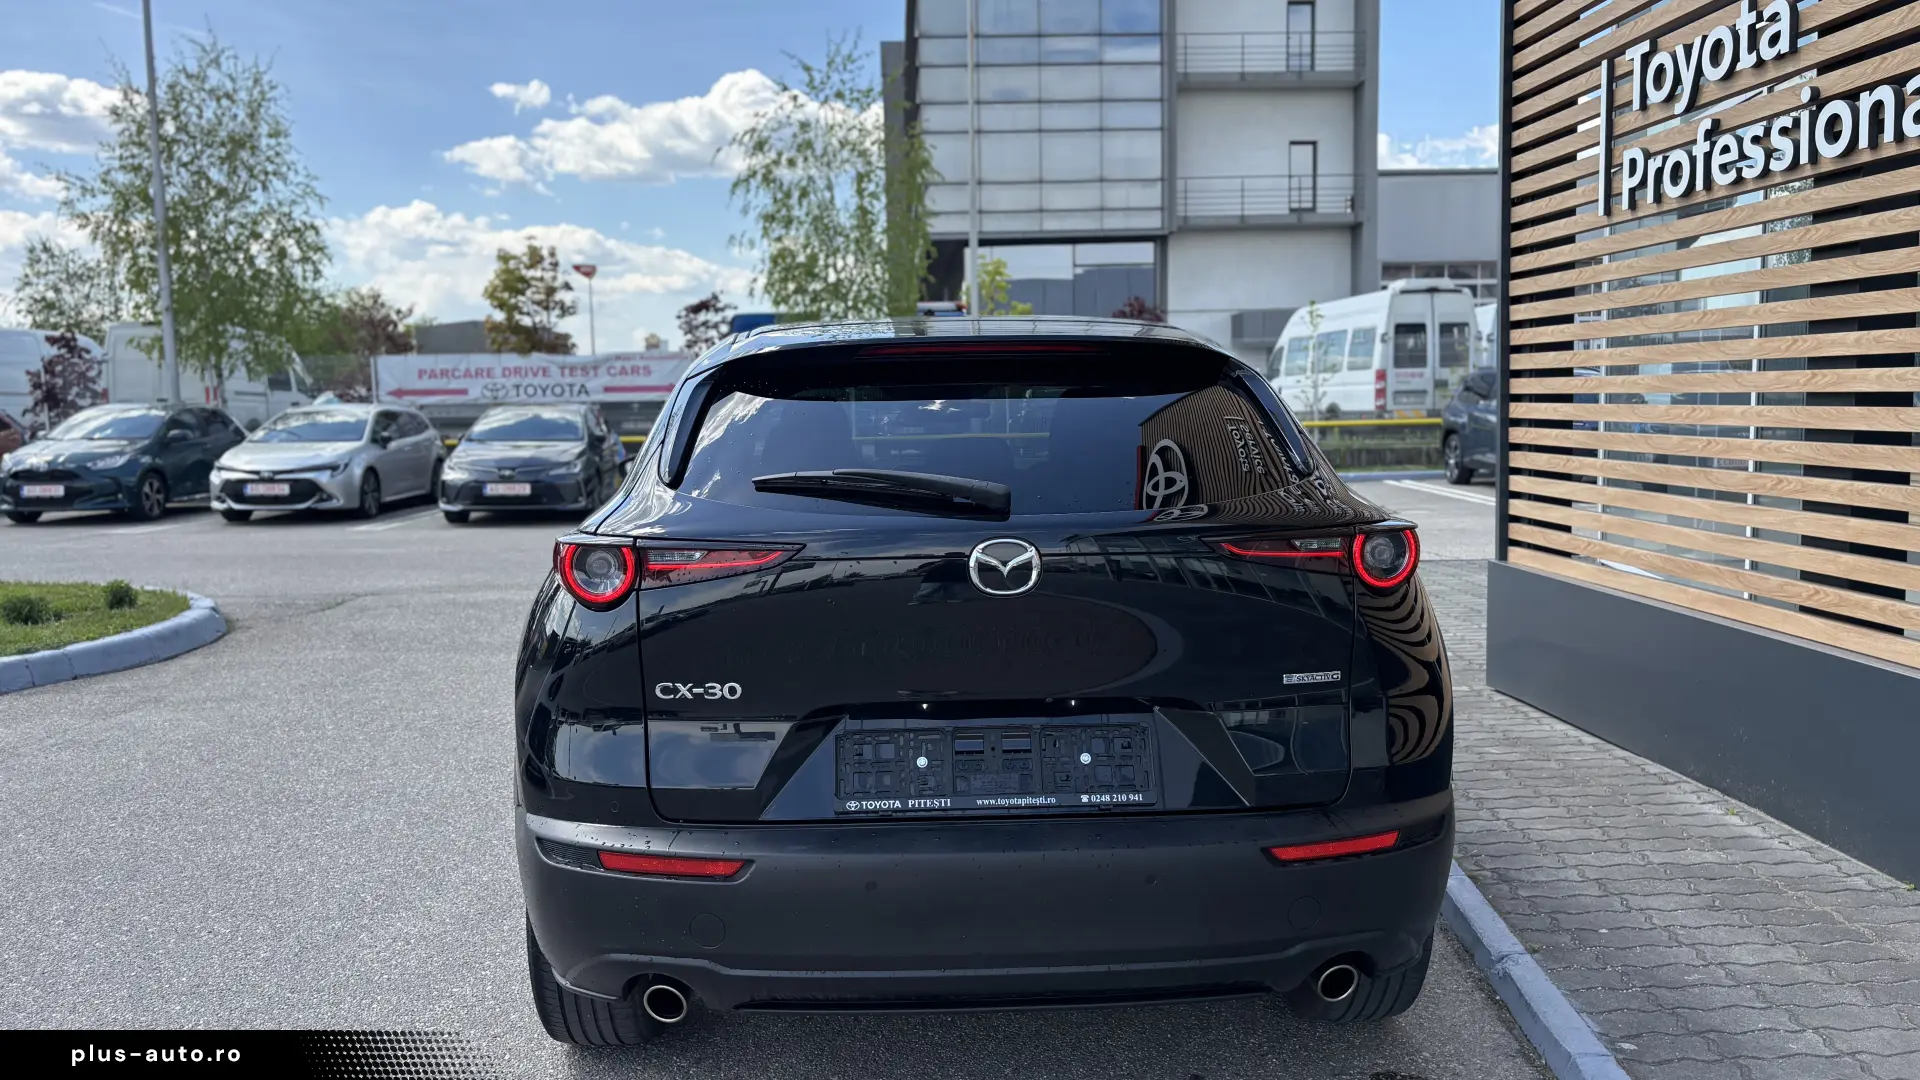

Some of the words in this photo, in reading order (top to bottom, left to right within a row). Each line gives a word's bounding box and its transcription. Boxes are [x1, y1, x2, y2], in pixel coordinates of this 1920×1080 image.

[1626, 0, 1794, 115] Toyota
[417, 365, 495, 380] PARCARE
[502, 365, 551, 379] DRIVE
[559, 364, 599, 378] TEST
[606, 364, 652, 378] CARS
[513, 383, 590, 398] TOYOTA
[655, 682, 742, 700] CX-30
[861, 800, 902, 809] TOYOTA
[1091, 794, 1110, 802] 0248
[1112, 794, 1127, 802] 210
[1128, 793, 1143, 801] 941
